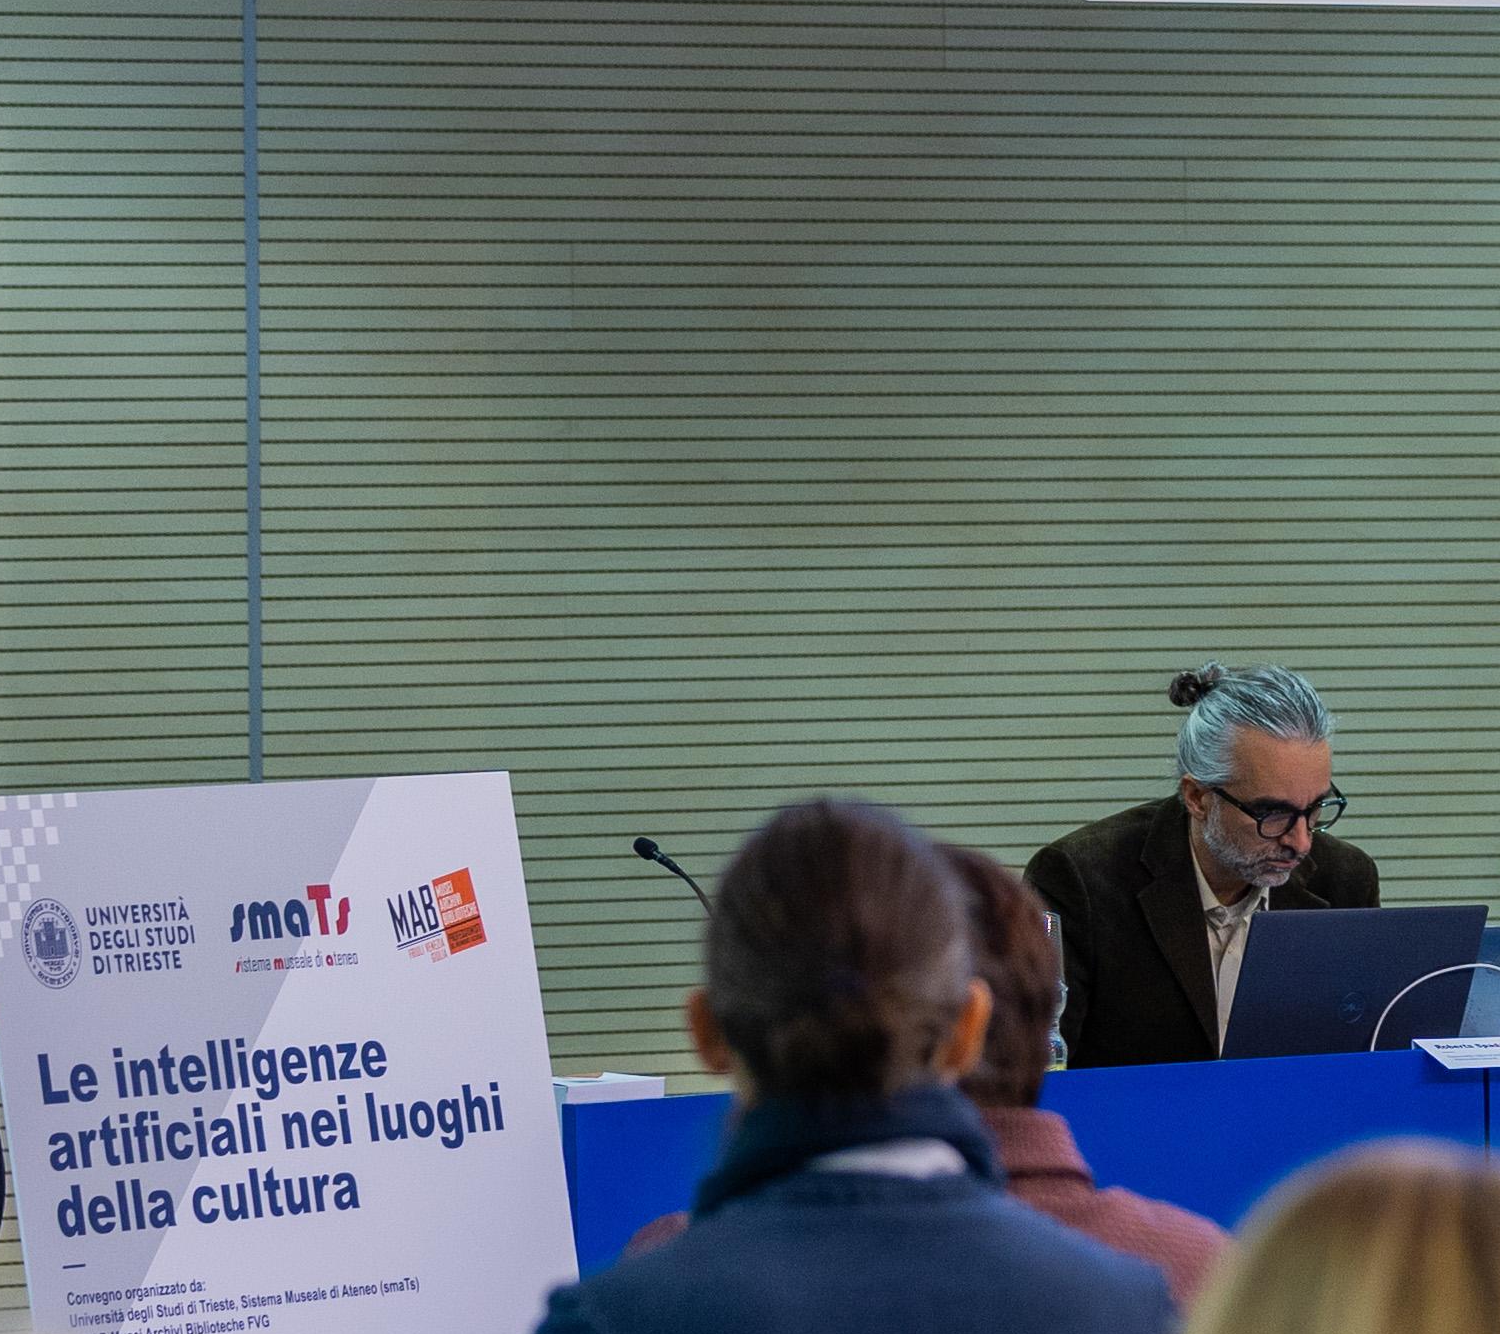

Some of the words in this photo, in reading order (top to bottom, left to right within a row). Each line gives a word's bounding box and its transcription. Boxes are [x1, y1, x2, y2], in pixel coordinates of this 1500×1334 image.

[85, 895, 190, 926] UNIVERSITÀ
[229, 883, 351, 943] smaTs
[386, 884, 440, 943] MAB
[88, 929, 140, 951] DEGLI
[146, 924, 196, 947] STUDI
[92, 955, 111, 975] DI
[114, 949, 182, 973] TRIESTE
[234, 950, 273, 973] sistema
[273, 949, 313, 971] museale
[313, 948, 324, 969] di
[326, 949, 359, 969] ateneo
[36, 1050, 99, 1105] Le
[112, 1037, 389, 1101] intelligenze
[47, 1098, 267, 1173] artificiali
[282, 1094, 351, 1151] nei
[365, 1081, 506, 1152] luoghi
[56, 1176, 176, 1238] della
[191, 1166, 360, 1225] cultura
[66, 1290, 122, 1307] Convegno
[125, 1282, 188, 1302] organizzato
[189, 1279, 207, 1294] da:
[127, 1304, 154, 1324] degli
[156, 1301, 185, 1319] Studi
[187, 1299, 197, 1316] di
[199, 1295, 239, 1315] Trieste,
[240, 1293, 283, 1311] Sistema
[284, 1286, 327, 1305] Museale
[329, 1284, 340, 1300] di
[341, 1282, 378, 1299] Ateneo
[380, 1276, 420, 1296] (smaTs)
[247, 1315, 270, 1330] FVG
